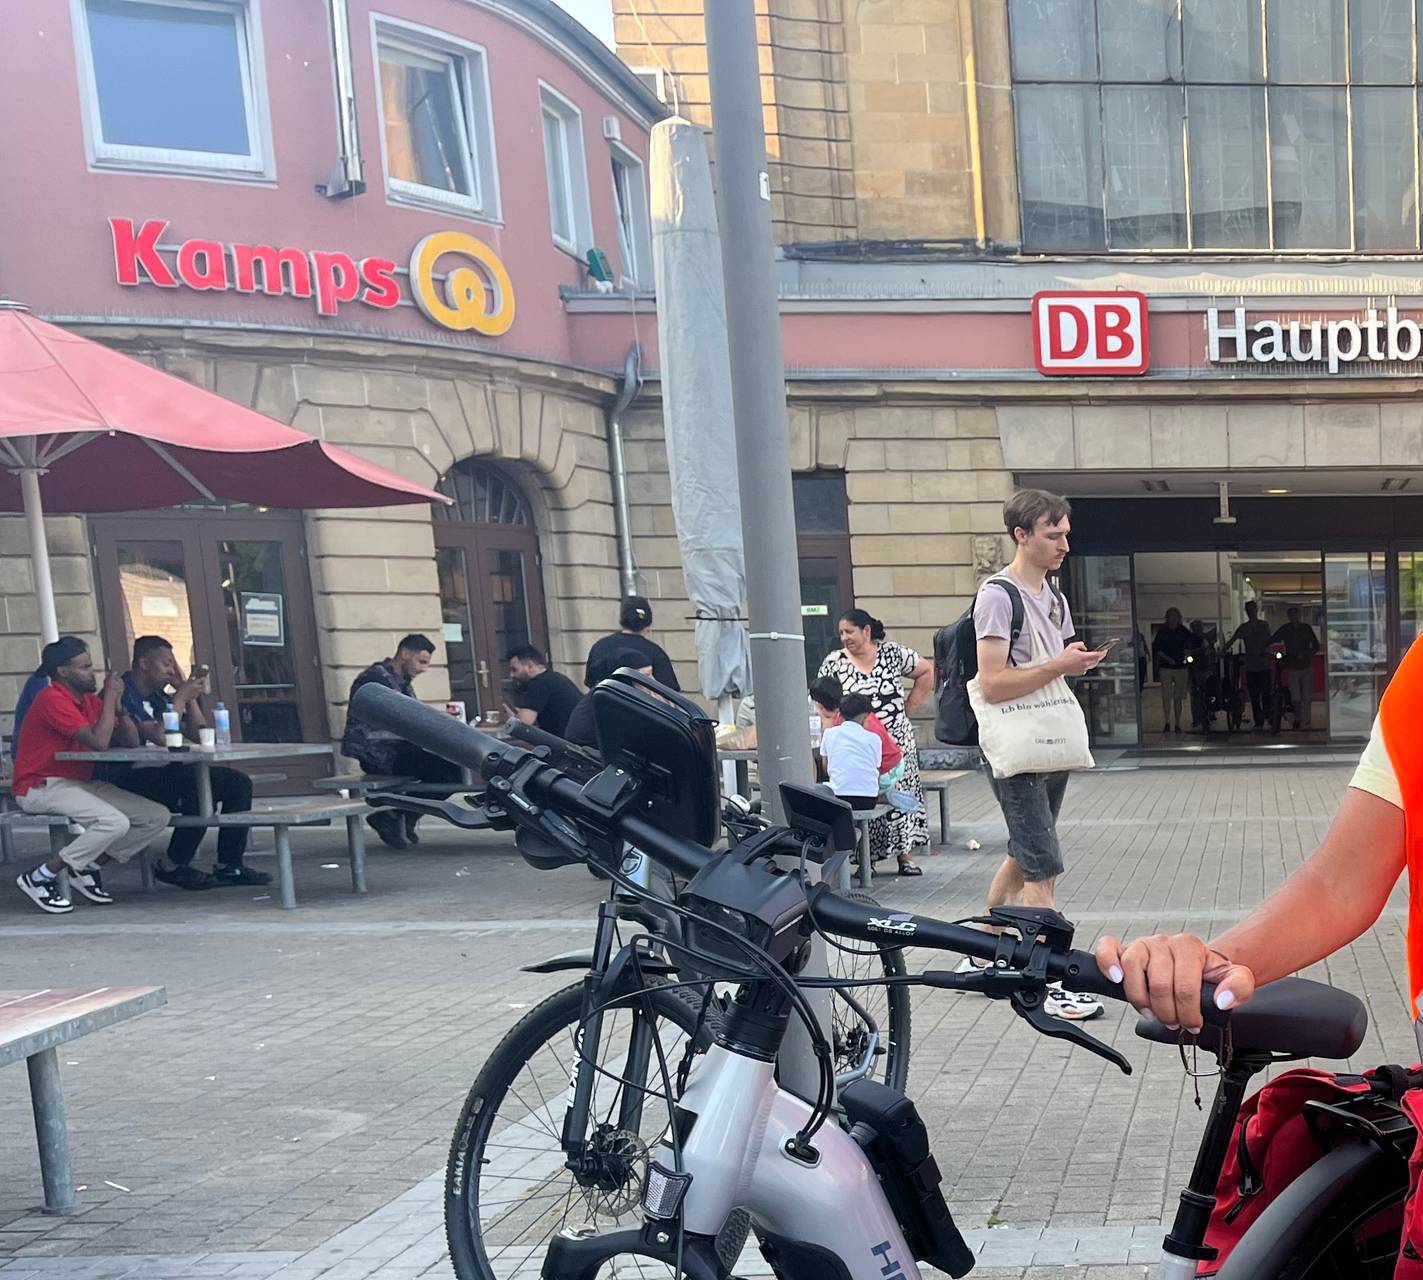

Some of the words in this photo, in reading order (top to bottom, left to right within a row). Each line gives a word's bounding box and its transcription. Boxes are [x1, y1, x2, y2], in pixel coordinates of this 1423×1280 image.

[107, 216, 401, 316] Kamps
[1047, 304, 1135, 360] DB
[1001, 702, 1015, 715] Ich
[867, 917, 918, 932] XLC
